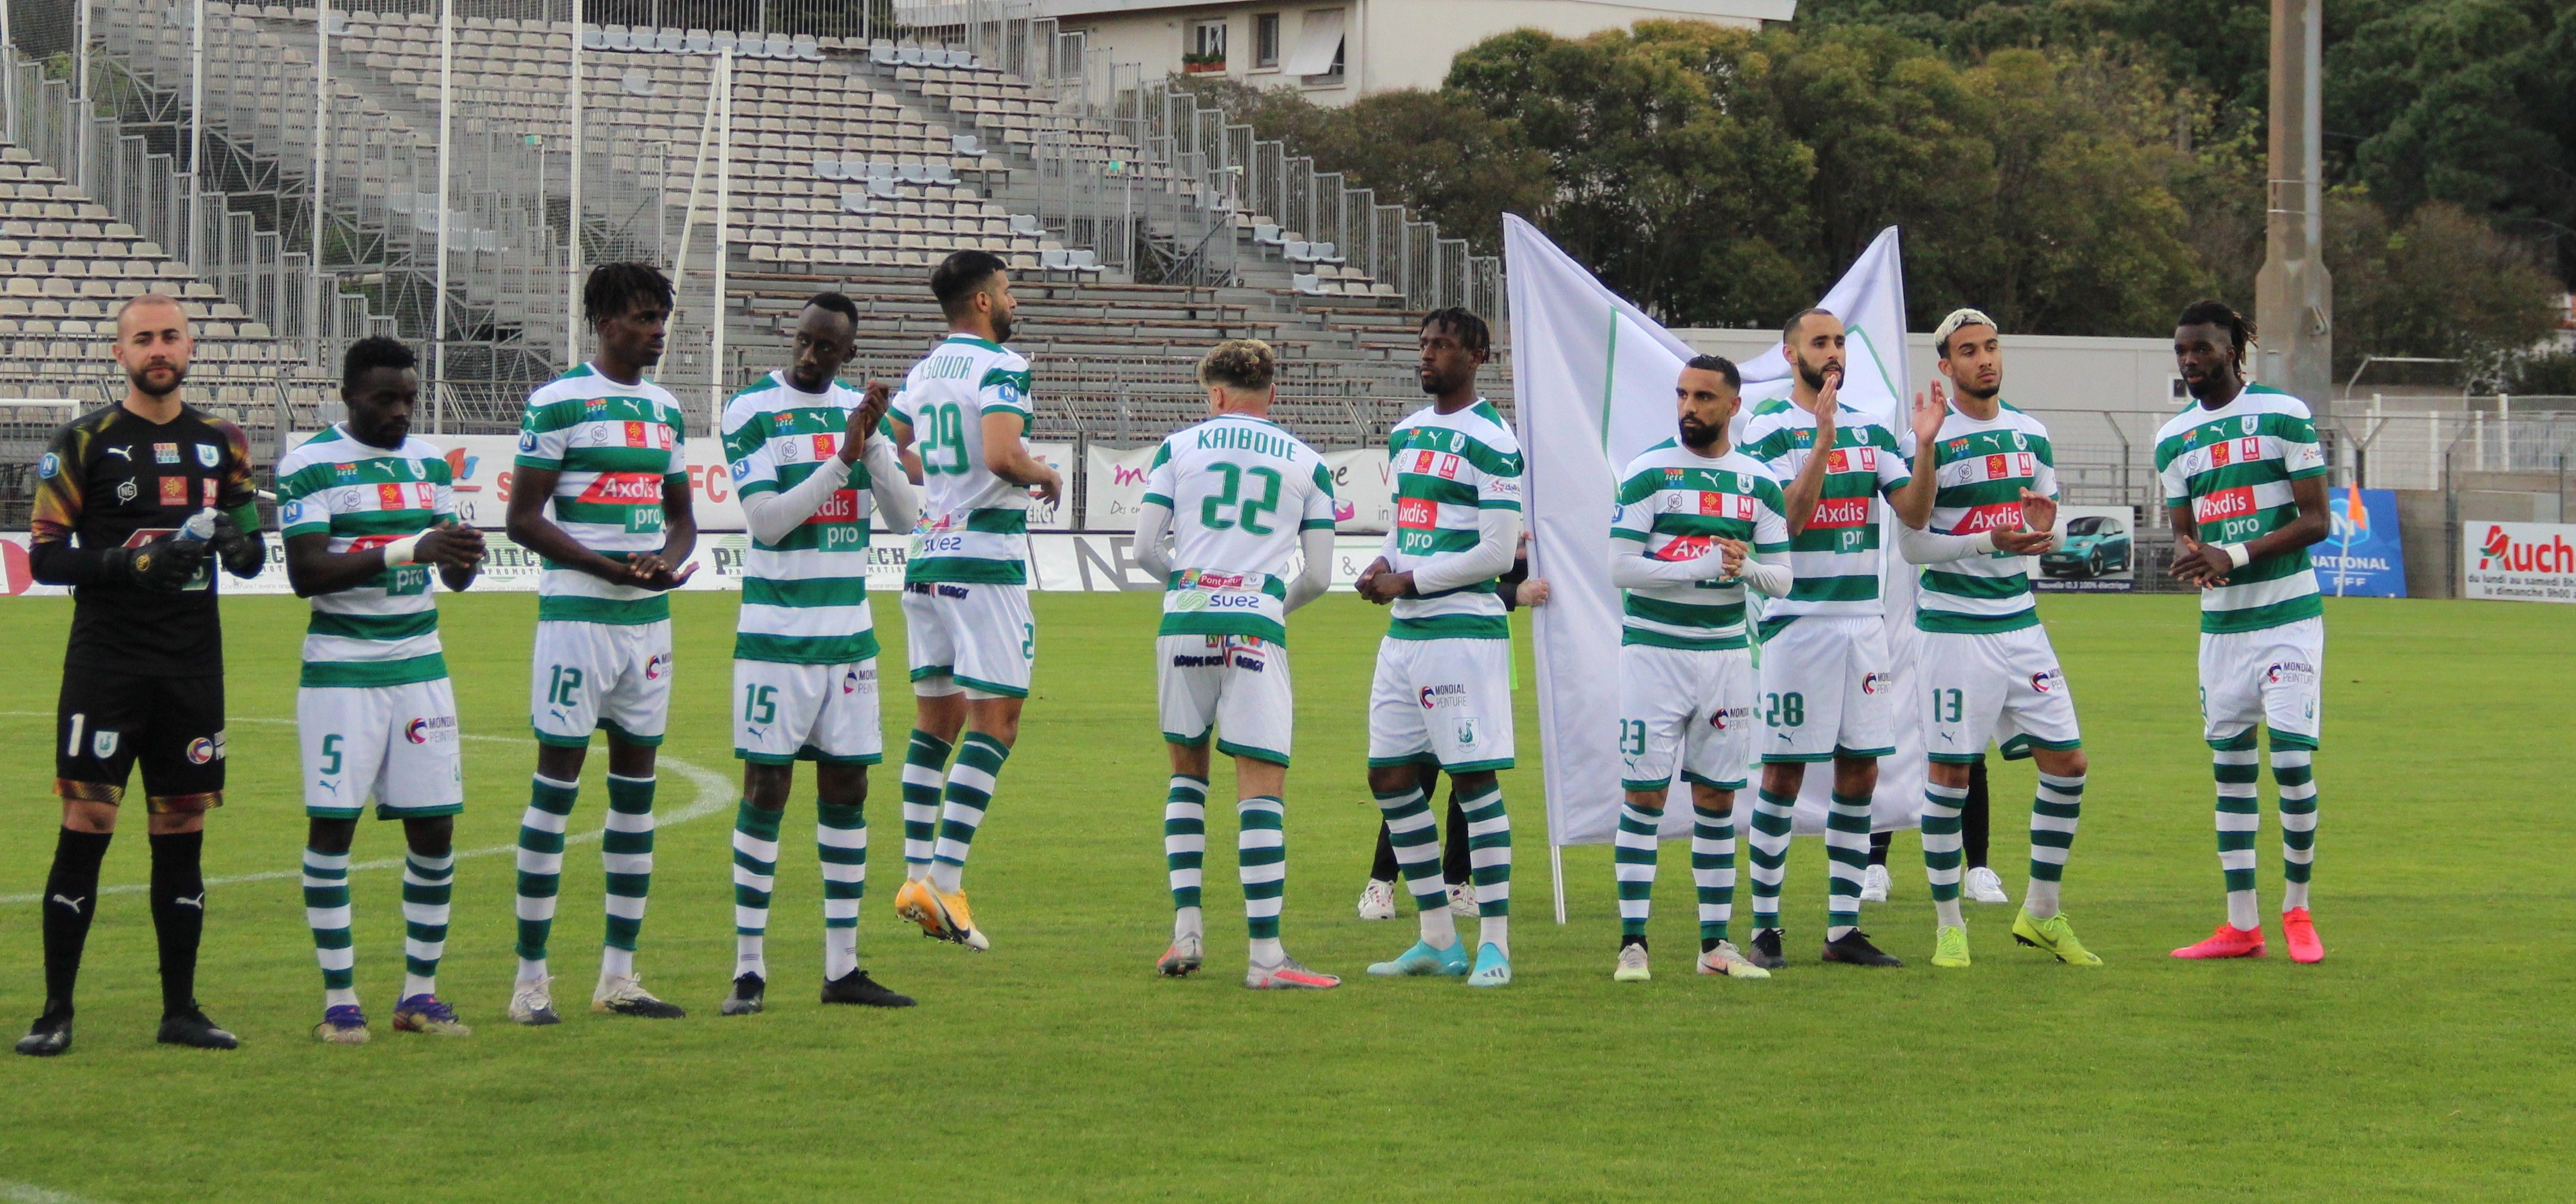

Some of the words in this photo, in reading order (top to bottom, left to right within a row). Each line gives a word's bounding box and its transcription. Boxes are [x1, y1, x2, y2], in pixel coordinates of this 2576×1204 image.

[918, 401, 970, 476] 29
[1197, 427, 1297, 461] KAIBOUE
[599, 476, 653, 498] Axdis
[686, 465, 728, 503] FC
[1111, 500, 1126, 515] Des
[1200, 460, 1281, 536] 22
[1670, 497, 1680, 506] NG
[2200, 492, 2247, 518] Axdis
[1813, 502, 1865, 524] Axdis
[1969, 506, 2020, 529] Axdis
[827, 527, 858, 548] pro
[2225, 517, 2260, 541] pro
[924, 537, 962, 551] suez
[1406, 532, 1433, 551] pro
[1843, 530, 1864, 551] pr
[2479, 525, 2574, 573] Auch
[1342, 555, 1359, 576] &
[395, 569, 424, 591] pro
[1201, 575, 1221, 586] Pont
[1210, 594, 1259, 609] suez
[548, 664, 583, 707] 12
[1435, 683, 1466, 695] MONDIAL
[745, 683, 778, 724] 15
[1436, 696, 1467, 709] PEINTURE
[1767, 691, 1805, 728] 28
[1932, 688, 1963, 723] 13
[68, 713, 85, 758] 1
[319, 733, 345, 776] 5
